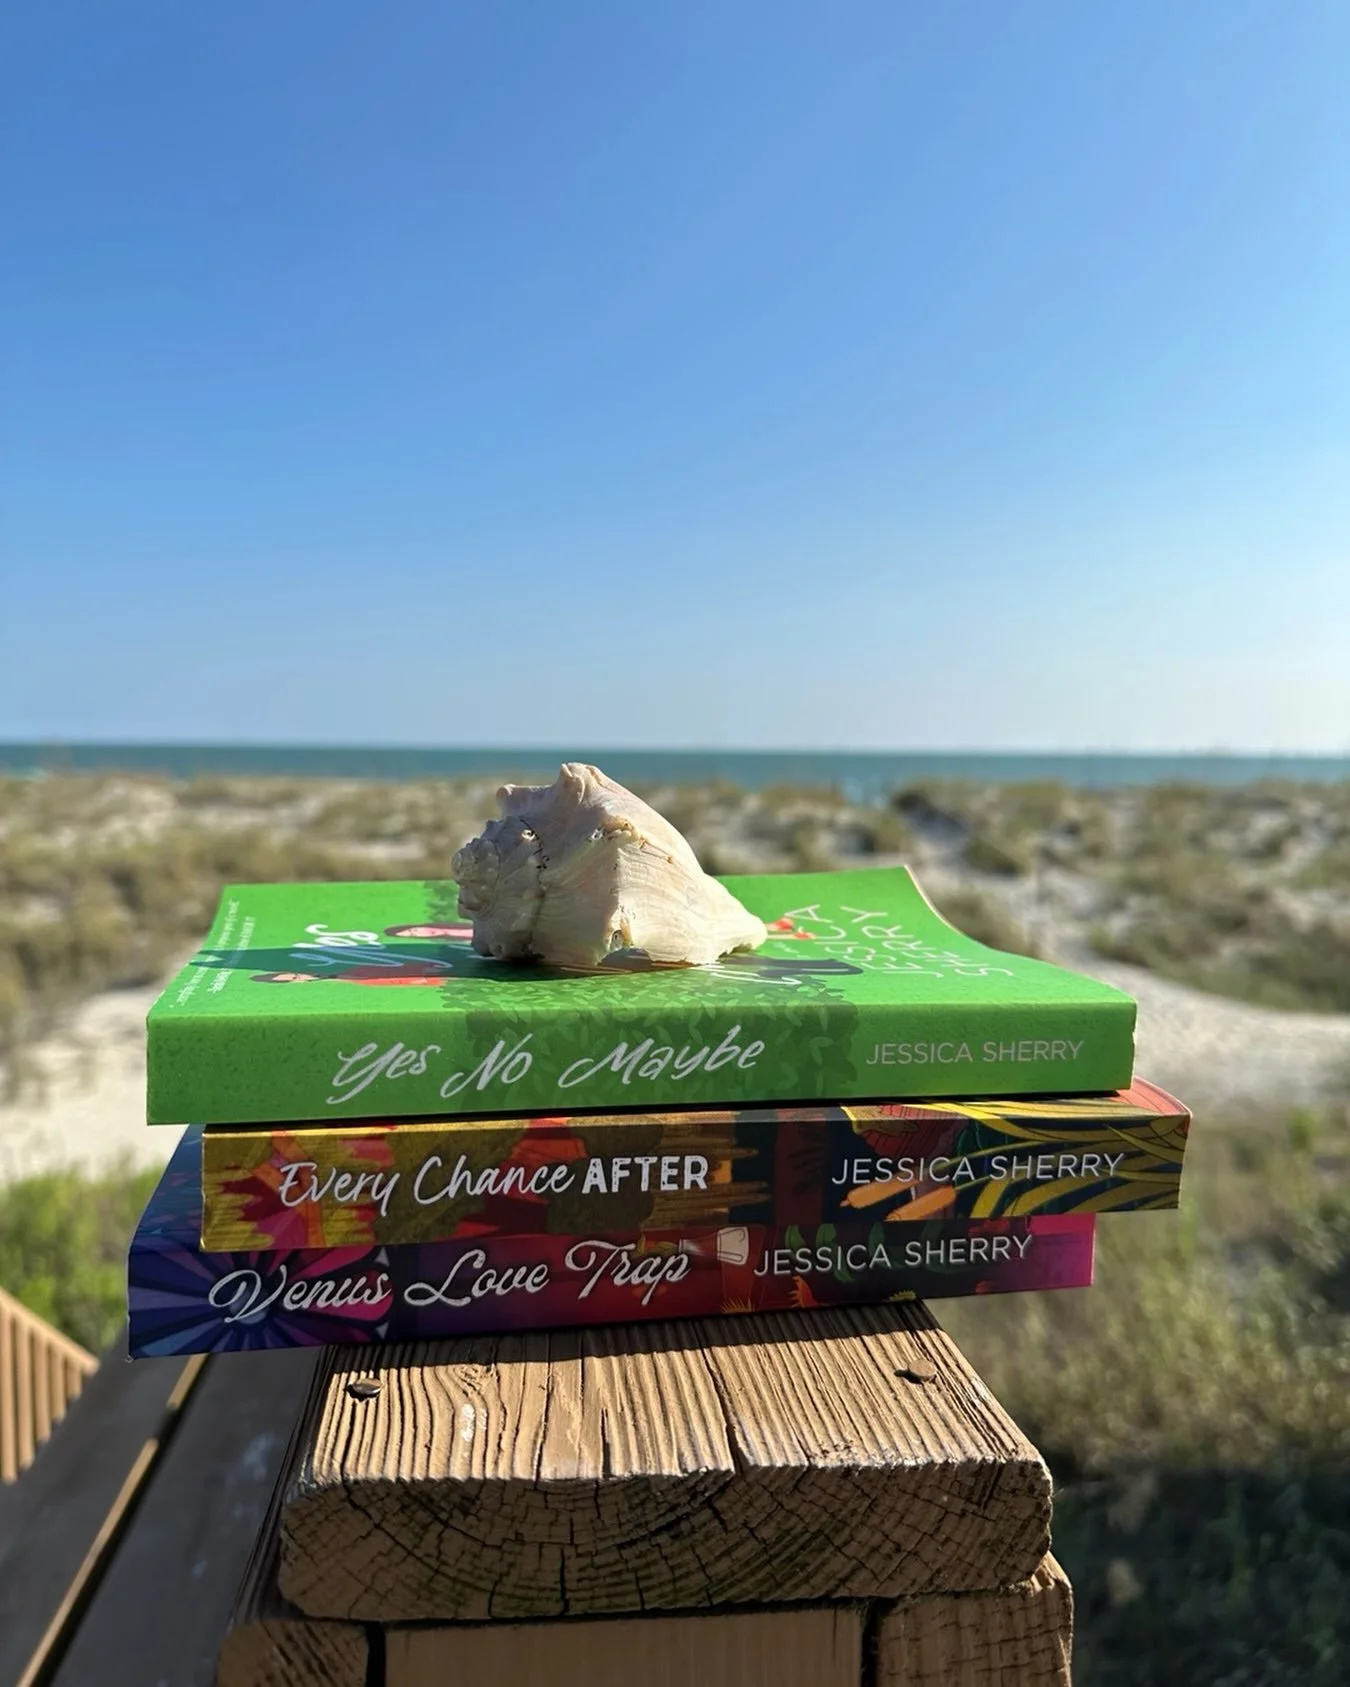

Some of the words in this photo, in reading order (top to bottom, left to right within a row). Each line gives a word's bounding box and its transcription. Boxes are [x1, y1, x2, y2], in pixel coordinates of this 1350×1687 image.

[289, 923, 453, 968] Yes
[785, 904, 943, 978] JESSICA
[840, 906, 1013, 977] SHERRY
[326, 1042, 442, 1104] Yes
[440, 1033, 533, 1098] No
[558, 1024, 766, 1089] Maybe
[866, 1042, 973, 1065] JESSICA
[983, 1040, 1084, 1062] SHERRY
[278, 1161, 400, 1216] Every
[414, 1154, 575, 1205] Chance
[582, 1154, 709, 1195] AFTER
[831, 1156, 974, 1186] JESSICA
[989, 1152, 1125, 1180] SHERRY
[208, 1264, 392, 1323] Venus
[403, 1249, 550, 1307] Love
[565, 1239, 692, 1306] Trap
[753, 1243, 892, 1278] JESSICA
[904, 1234, 1033, 1266] SHERRY
